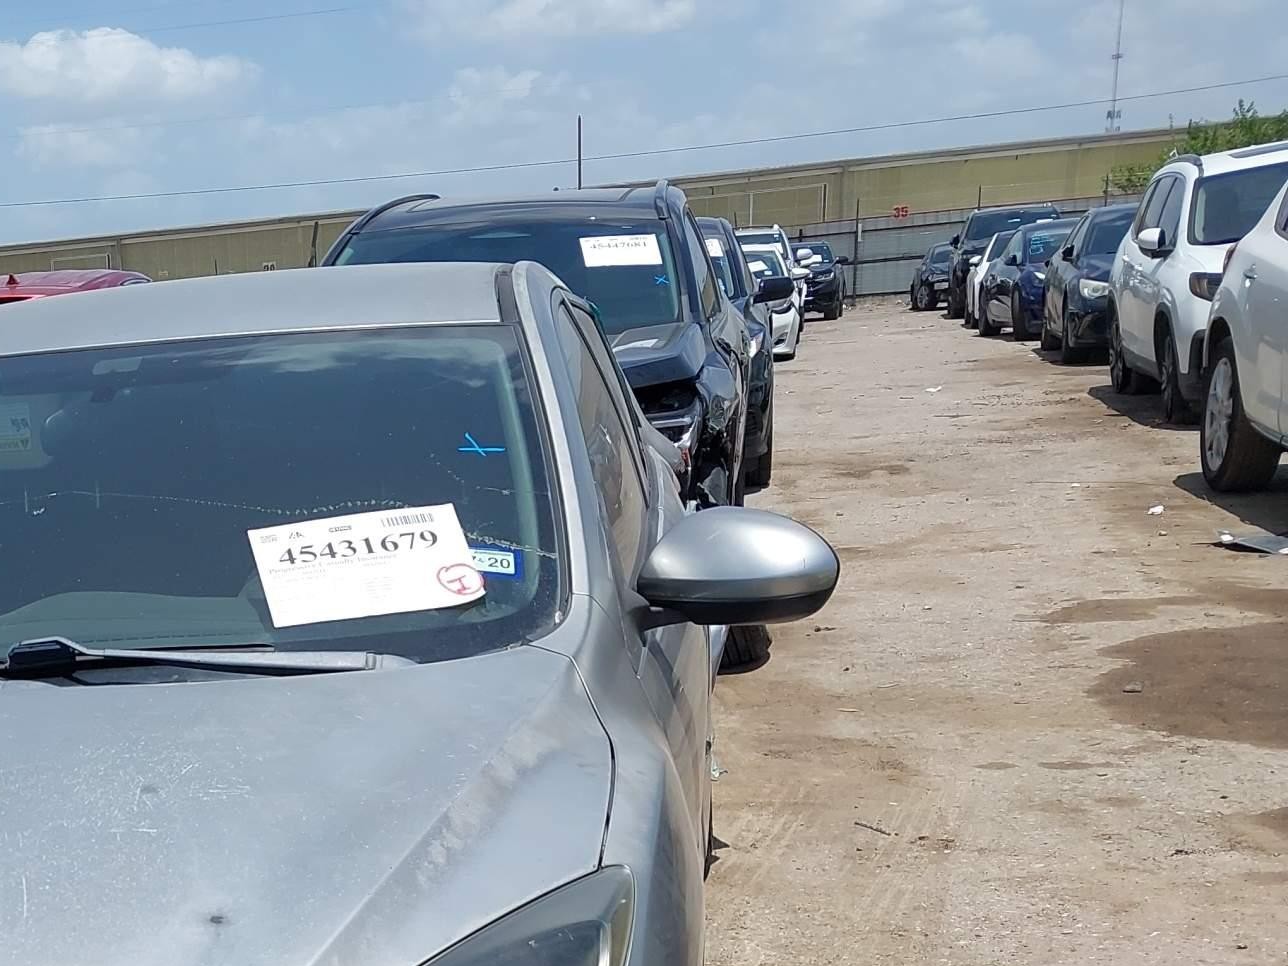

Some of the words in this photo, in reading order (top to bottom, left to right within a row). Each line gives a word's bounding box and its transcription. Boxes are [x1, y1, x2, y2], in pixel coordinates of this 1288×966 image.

[893, 206, 909, 218] 35
[279, 530, 438, 565] 45431679
[487, 557, 511, 569] 20
